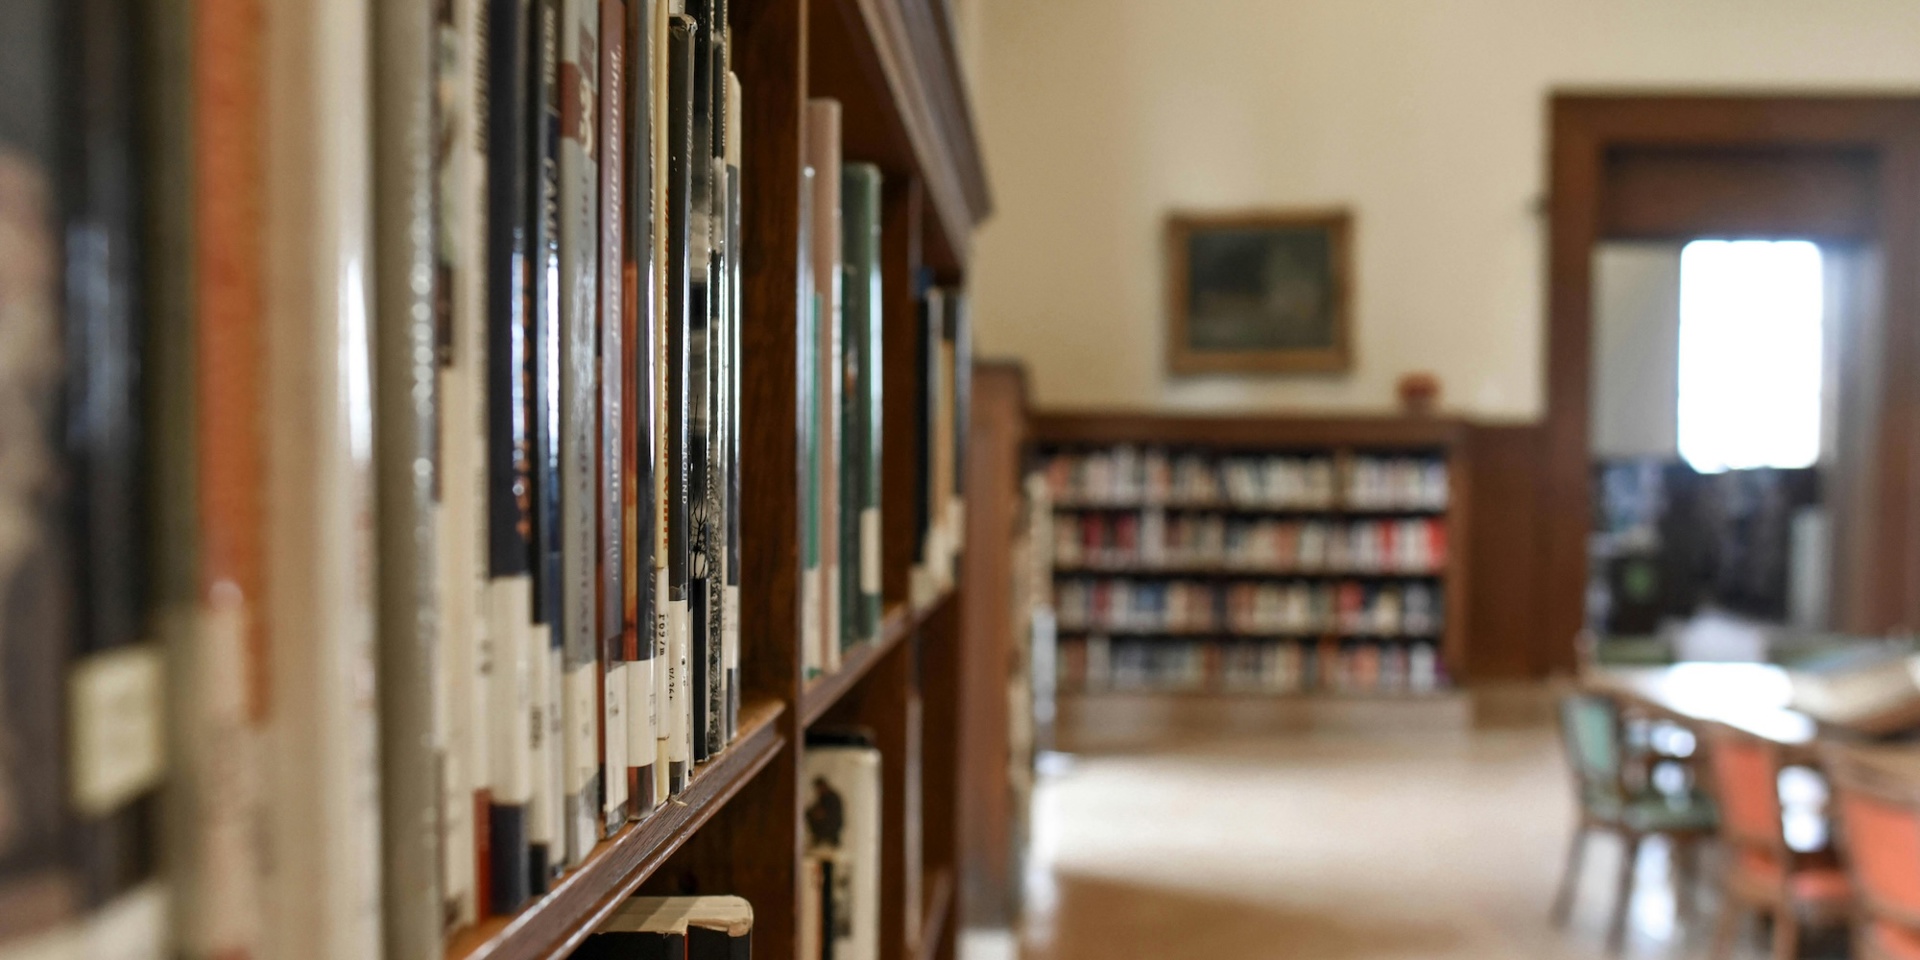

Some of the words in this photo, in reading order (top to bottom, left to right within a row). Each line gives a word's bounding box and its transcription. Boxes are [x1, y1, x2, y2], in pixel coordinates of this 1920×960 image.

[609, 51, 620, 239] photography
[611, 245, 620, 340] reader
[681, 441, 689, 505] AROUND
